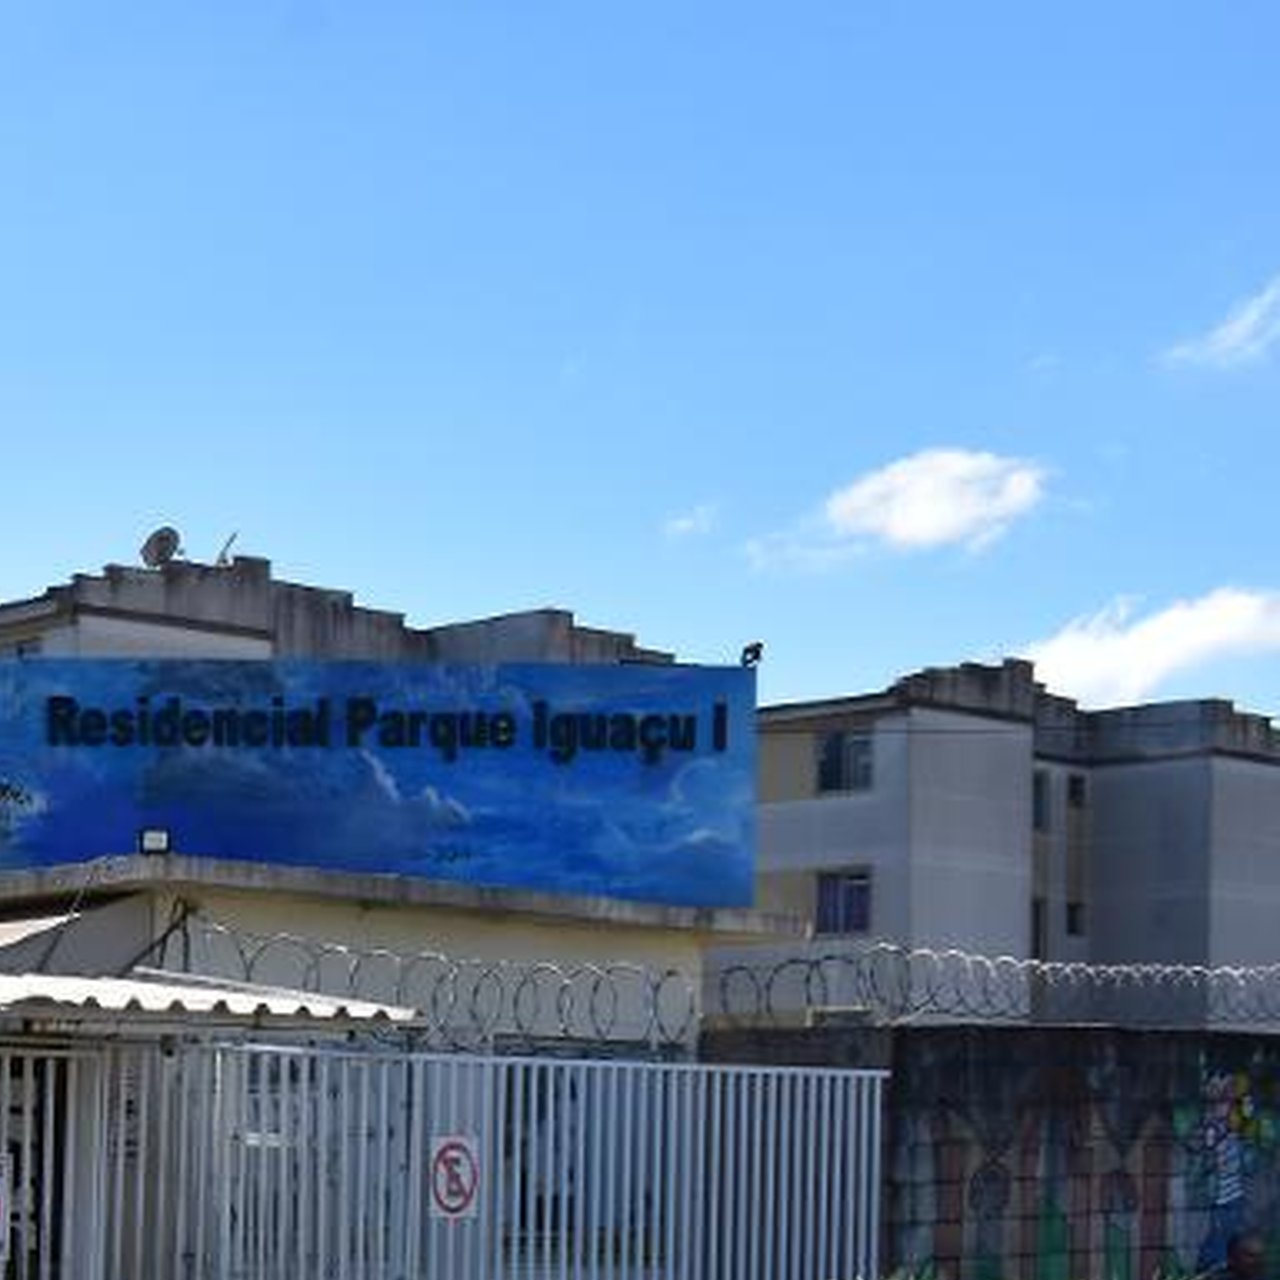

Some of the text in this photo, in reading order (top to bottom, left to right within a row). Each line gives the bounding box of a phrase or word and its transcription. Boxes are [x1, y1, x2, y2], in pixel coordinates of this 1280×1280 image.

[46, 695, 330, 747] Residencial
[345, 697, 518, 765] Parque
[534, 699, 696, 766] Iguaçu
